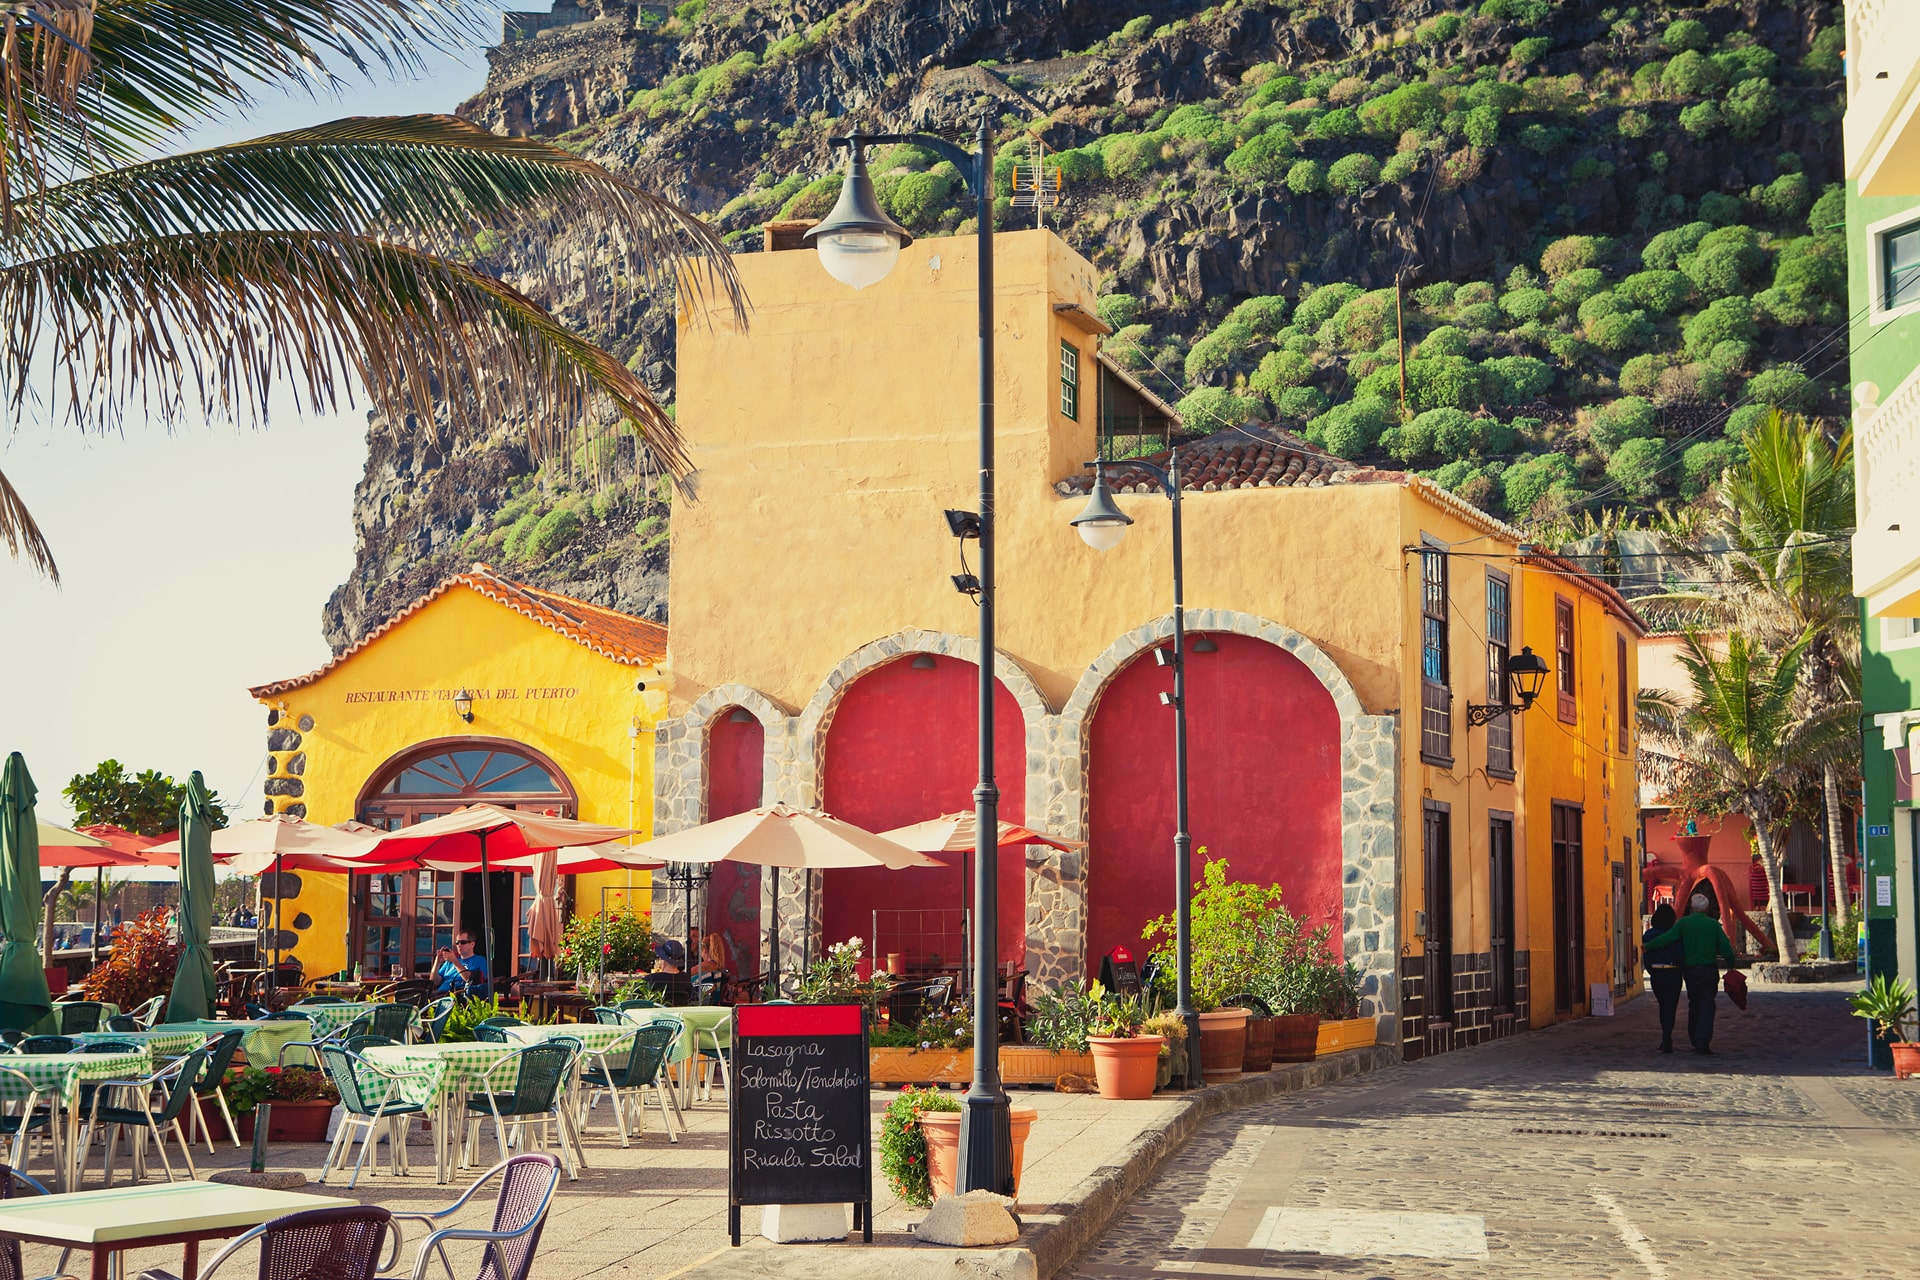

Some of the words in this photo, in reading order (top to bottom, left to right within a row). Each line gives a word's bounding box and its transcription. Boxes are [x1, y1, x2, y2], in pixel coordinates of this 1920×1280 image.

[345, 690, 429, 704] RESTAURANTE
[496, 688, 518, 700] DEL
[747, 1039, 825, 1067] Lasagna
[766, 1092, 825, 1121] Pasta
[754, 1119, 836, 1142] Rissotto
[809, 1143, 864, 1168] Salad
